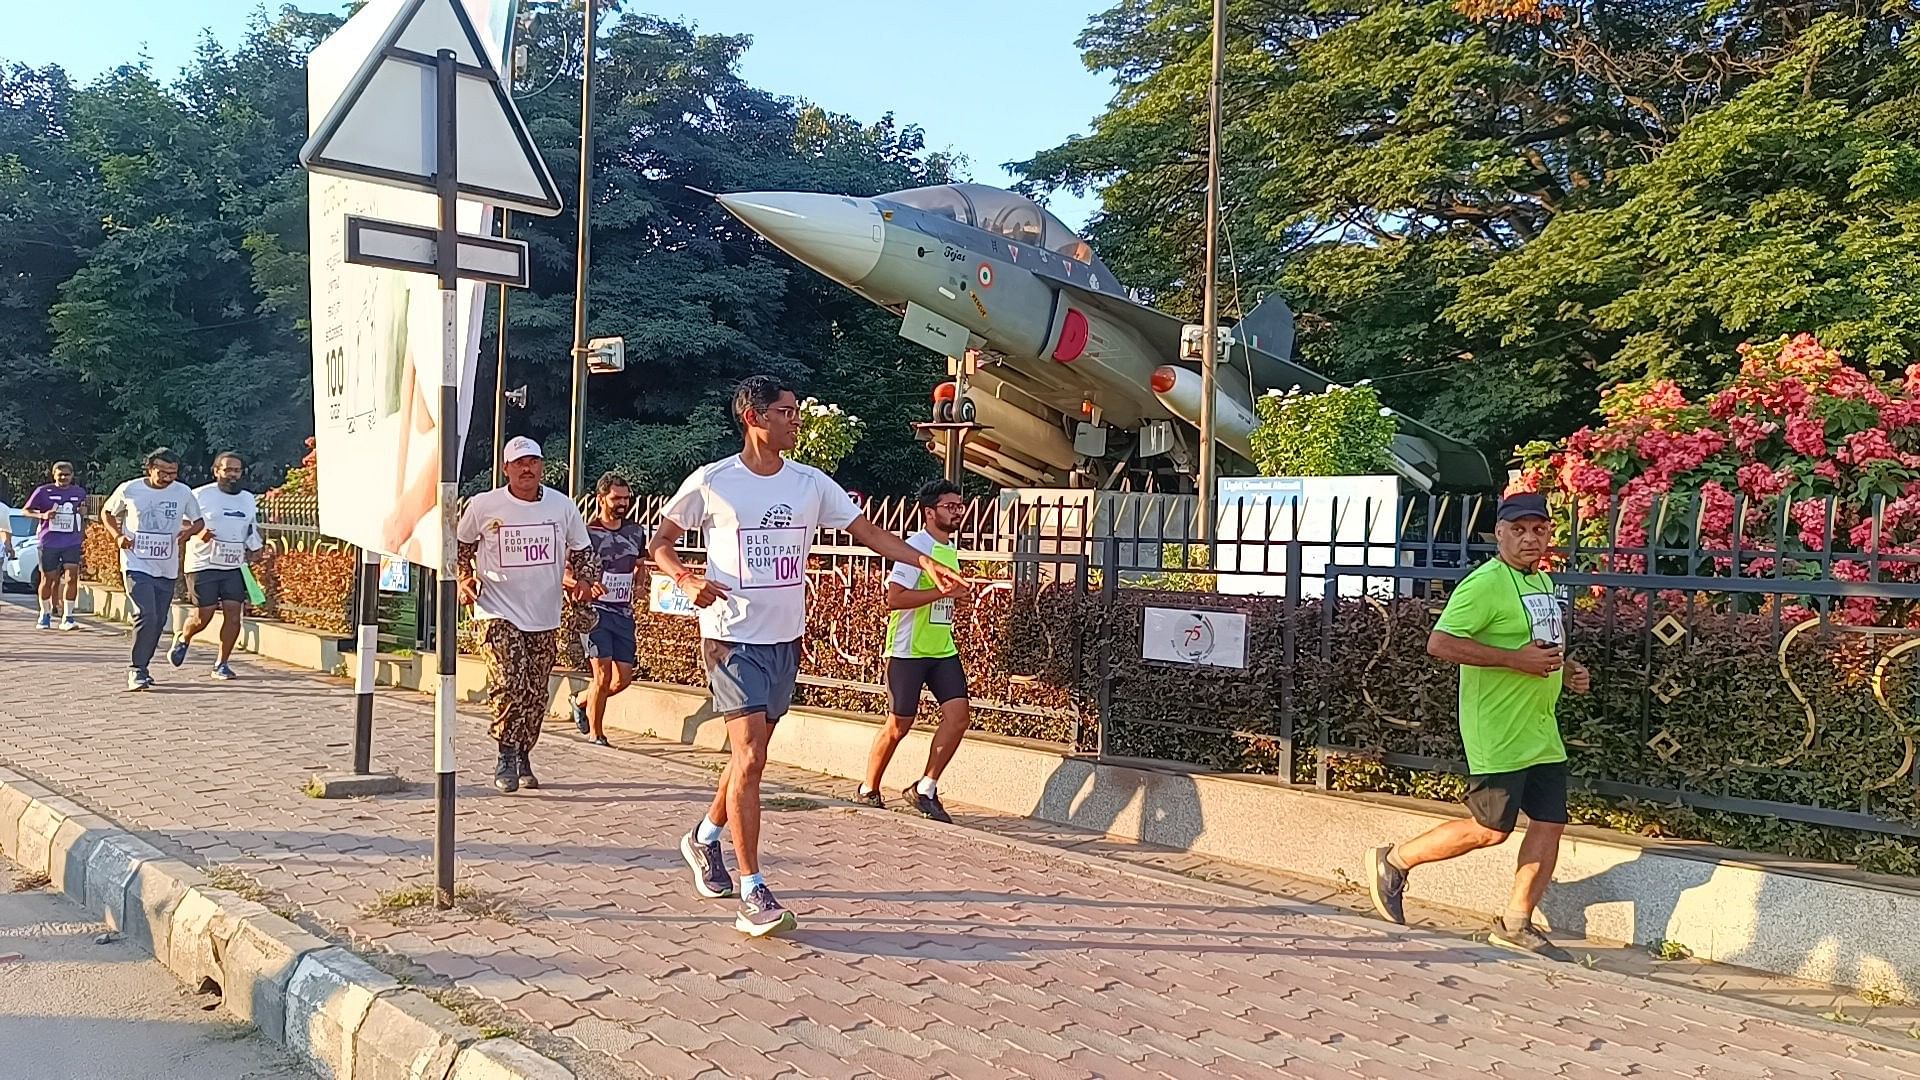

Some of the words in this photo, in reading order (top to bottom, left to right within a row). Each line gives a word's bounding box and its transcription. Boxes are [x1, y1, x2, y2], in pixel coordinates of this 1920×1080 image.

[943, 246, 966, 261] Tejas
[326, 346, 344, 398] 100
[504, 530, 521, 538] BLR
[746, 534, 769, 545] BLR
[504, 536, 550, 546] FOOTPATH
[149, 546, 169, 557] 10K
[505, 545, 523, 553] RUN
[523, 543, 550, 562] 10K
[747, 545, 801, 556] FOOTPATH
[224, 553, 241, 564] 10K
[747, 557, 771, 568] RUN
[772, 555, 800, 581] 10K
[615, 586, 630, 600] 10K
[1184, 625, 1202, 647] 75
